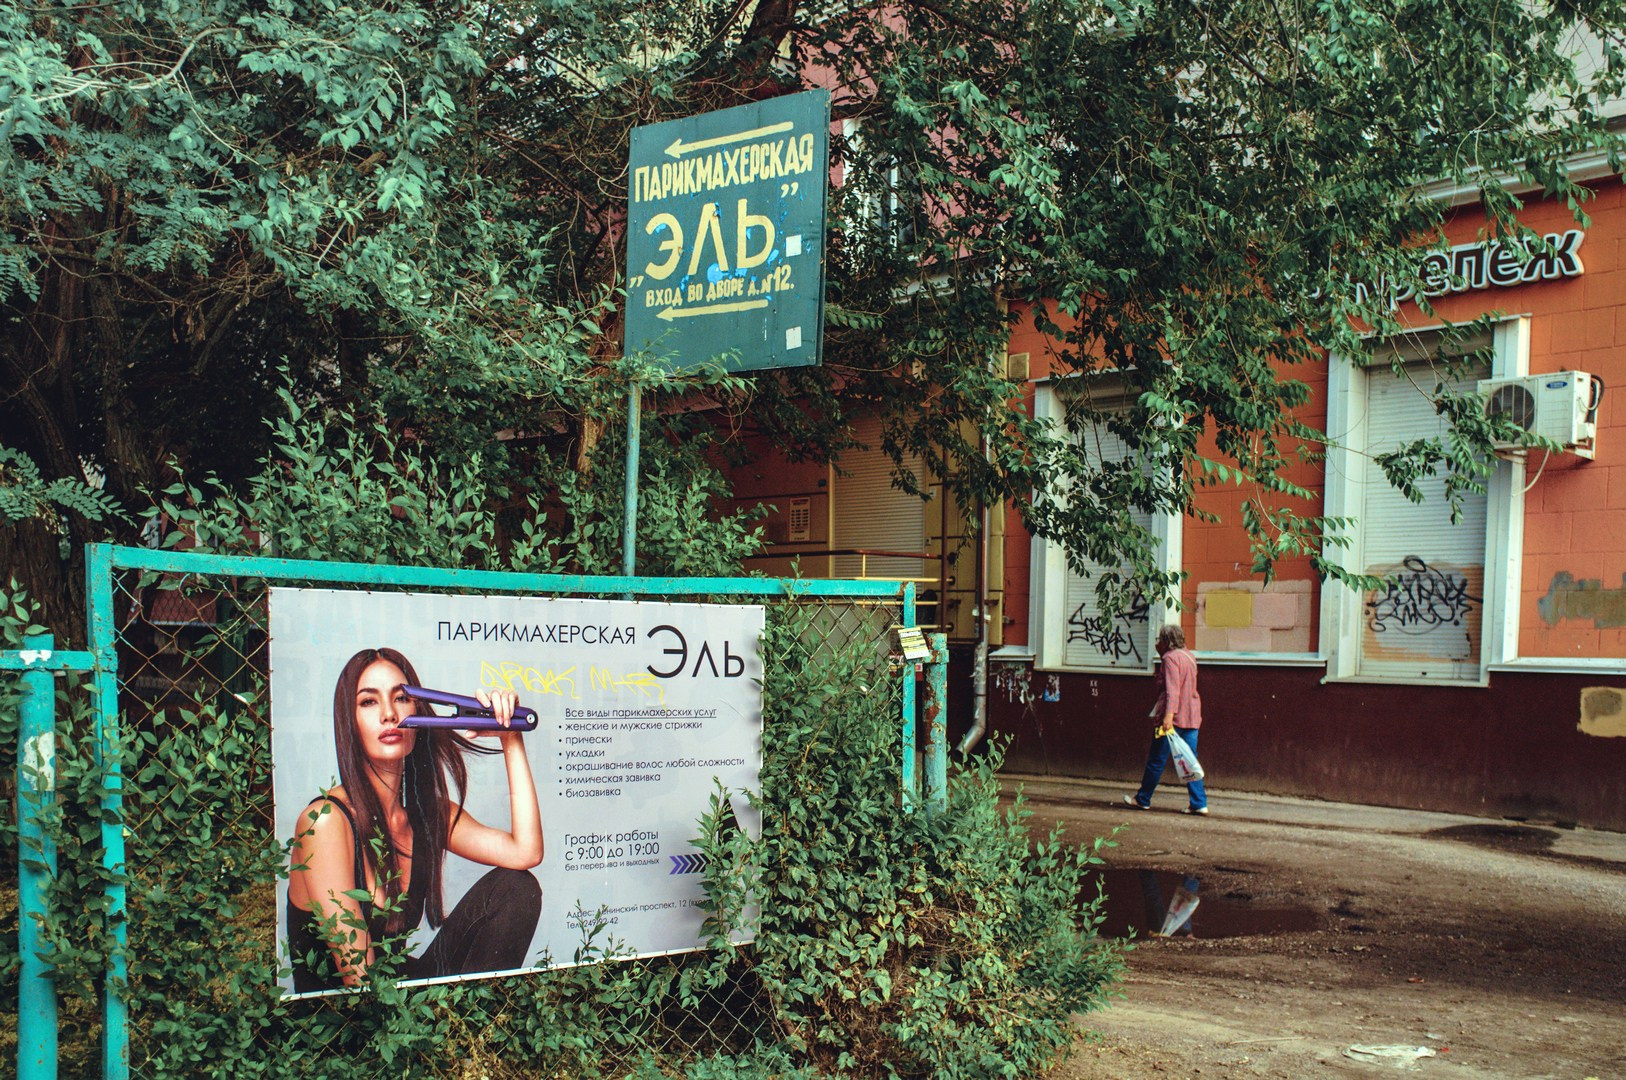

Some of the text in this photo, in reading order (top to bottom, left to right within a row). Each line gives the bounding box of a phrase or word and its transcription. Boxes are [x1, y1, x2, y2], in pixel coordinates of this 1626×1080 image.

[635, 133, 814, 202] ПАРИКМАХЕРСКАЯ
[1345, 230, 1585, 317] репеж
[645, 287, 683, 307] ВХОД
[687, 283, 703, 303] ВО
[706, 278, 745, 302] ДВОРЕ
[438, 621, 636, 645] ПАРИКМАХЕРСКАЯ
[565, 708, 717, 719] Все виды парикмахерских услуг
[565, 723, 609, 731] женские
[620, 722, 663, 732] мужские
[664, 721, 703, 731] стрижки
[565, 736, 613, 746] прически
[565, 750, 605, 760] укладки
[565, 758, 745, 773] окрашивание волос любой сложности
[565, 773, 661, 785] химическая завивка
[565, 788, 621, 798] биозавивка
[564, 829, 659, 847] График работы
[577, 846, 604, 860] 9:00
[607, 848, 624, 859] до
[629, 842, 660, 856] 19:00
[565, 863, 579, 871] без
[626, 858, 660, 867] выходных
[596, 903, 638, 916] енинский
[639, 901, 677, 913] проспект,
[679, 899, 687, 908] 12
